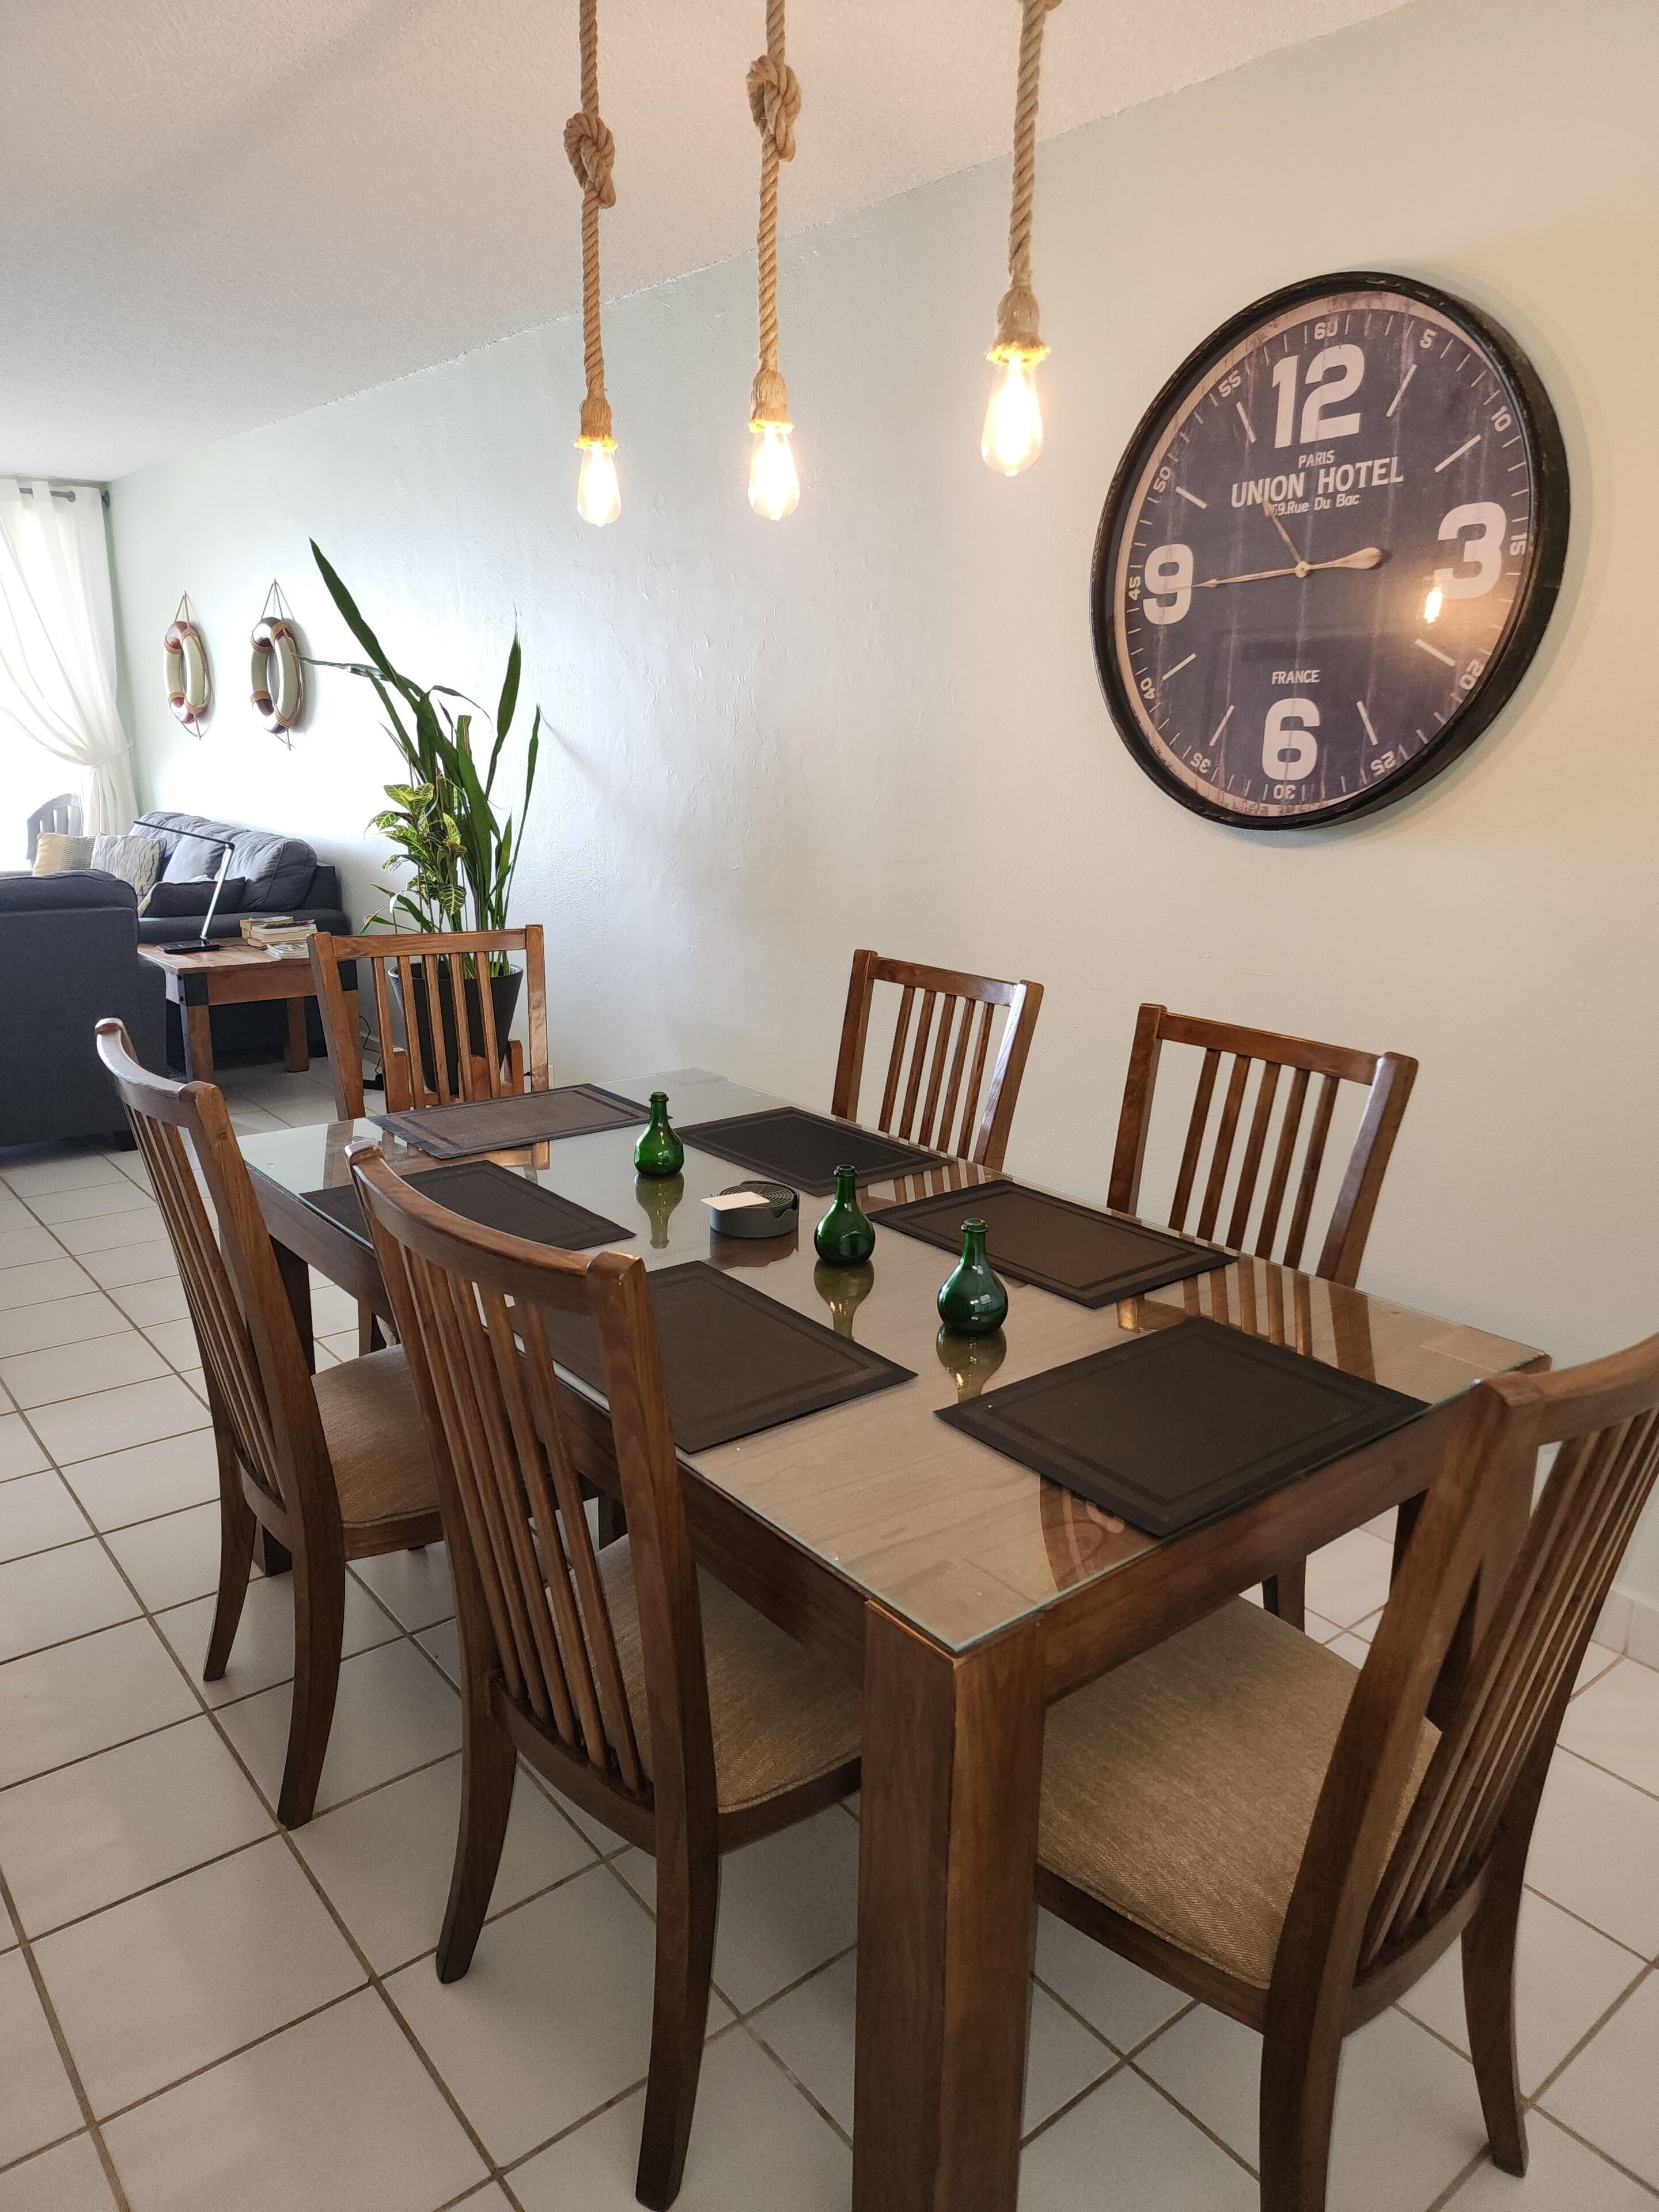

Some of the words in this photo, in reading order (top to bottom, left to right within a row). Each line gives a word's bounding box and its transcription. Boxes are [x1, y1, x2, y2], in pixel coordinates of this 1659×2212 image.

[1314, 320, 1338, 340] 60
[1420, 328, 1437, 349] 5
[1218, 370, 1241, 397] 55
[1272, 344, 1365, 449] 12
[1491, 406, 1512, 432] 10
[1298, 449, 1335, 469] PARIS
[1153, 466, 1172, 493] 50
[1231, 472, 1305, 508] UNION
[1317, 456, 1404, 495] HOTEL
[1314, 497, 1331, 511] Du
[1336, 493, 1361, 507] Bac
[1433, 502, 1506, 600] 3
[1510, 532, 1527, 556] 15
[1128, 576, 1141, 601] 45
[1143, 544, 1194, 625] 9
[1271, 669, 1321, 685] FRANCE
[1459, 659, 1484, 691] 20
[1140, 677, 1156, 700] 40
[1262, 698, 1320, 781] 6
[1190, 752, 1211, 774] 35
[1370, 751, 1396, 777] 25
[1273, 784, 1296, 800] 30
